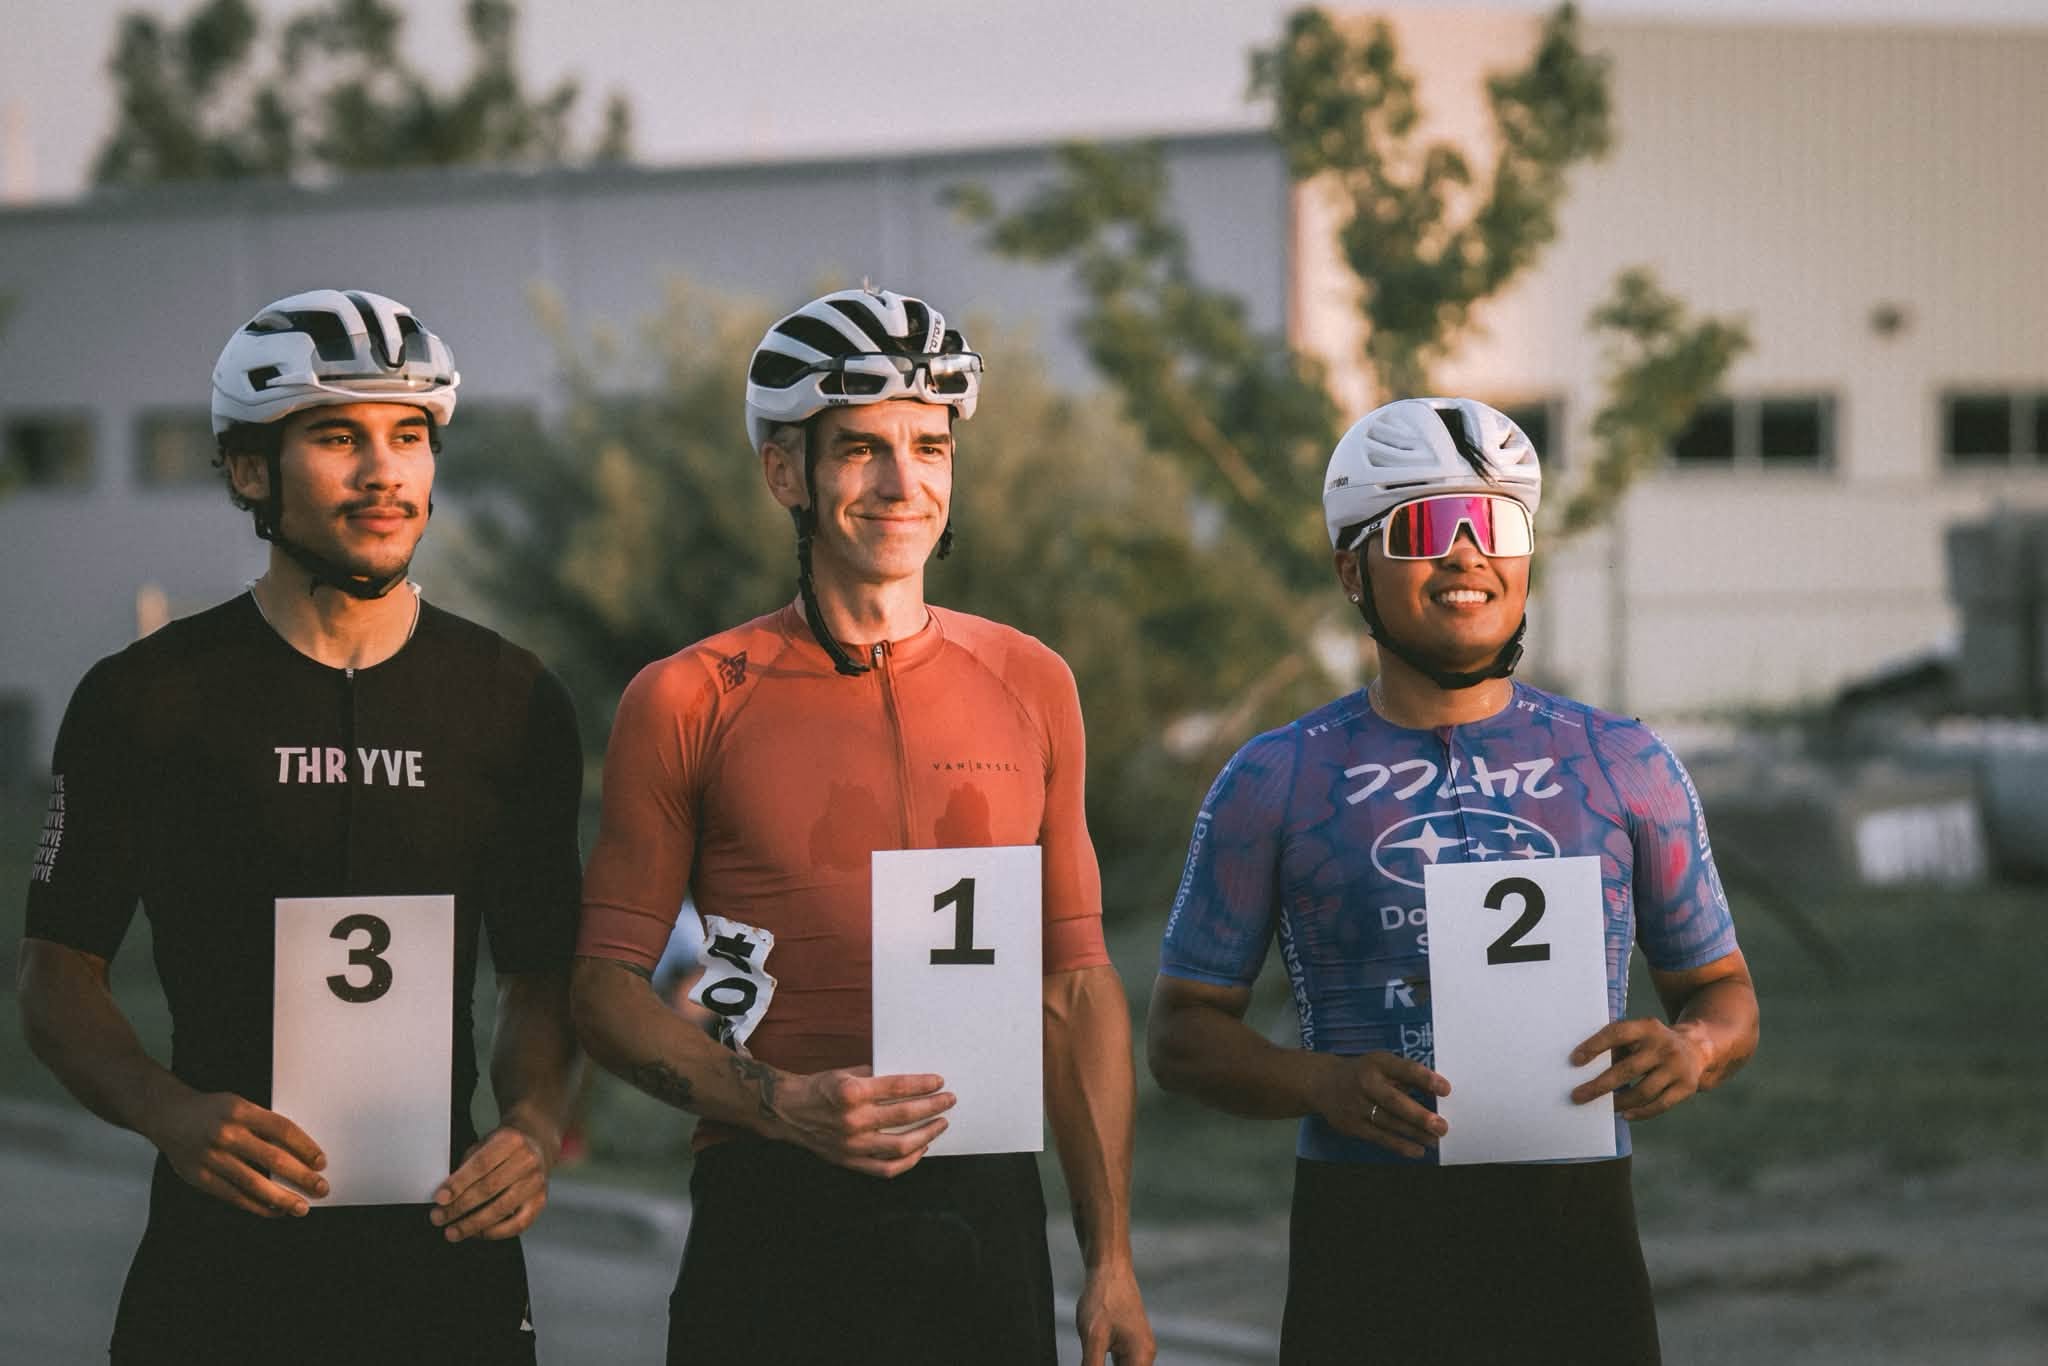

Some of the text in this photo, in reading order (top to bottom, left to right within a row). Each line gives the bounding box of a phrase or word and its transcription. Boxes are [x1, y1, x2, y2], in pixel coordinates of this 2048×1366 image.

[326, 913, 393, 1004] 3
[929, 878, 995, 965] 1
[1380, 905, 1427, 930] Do
[1483, 877, 1551, 966] 2
